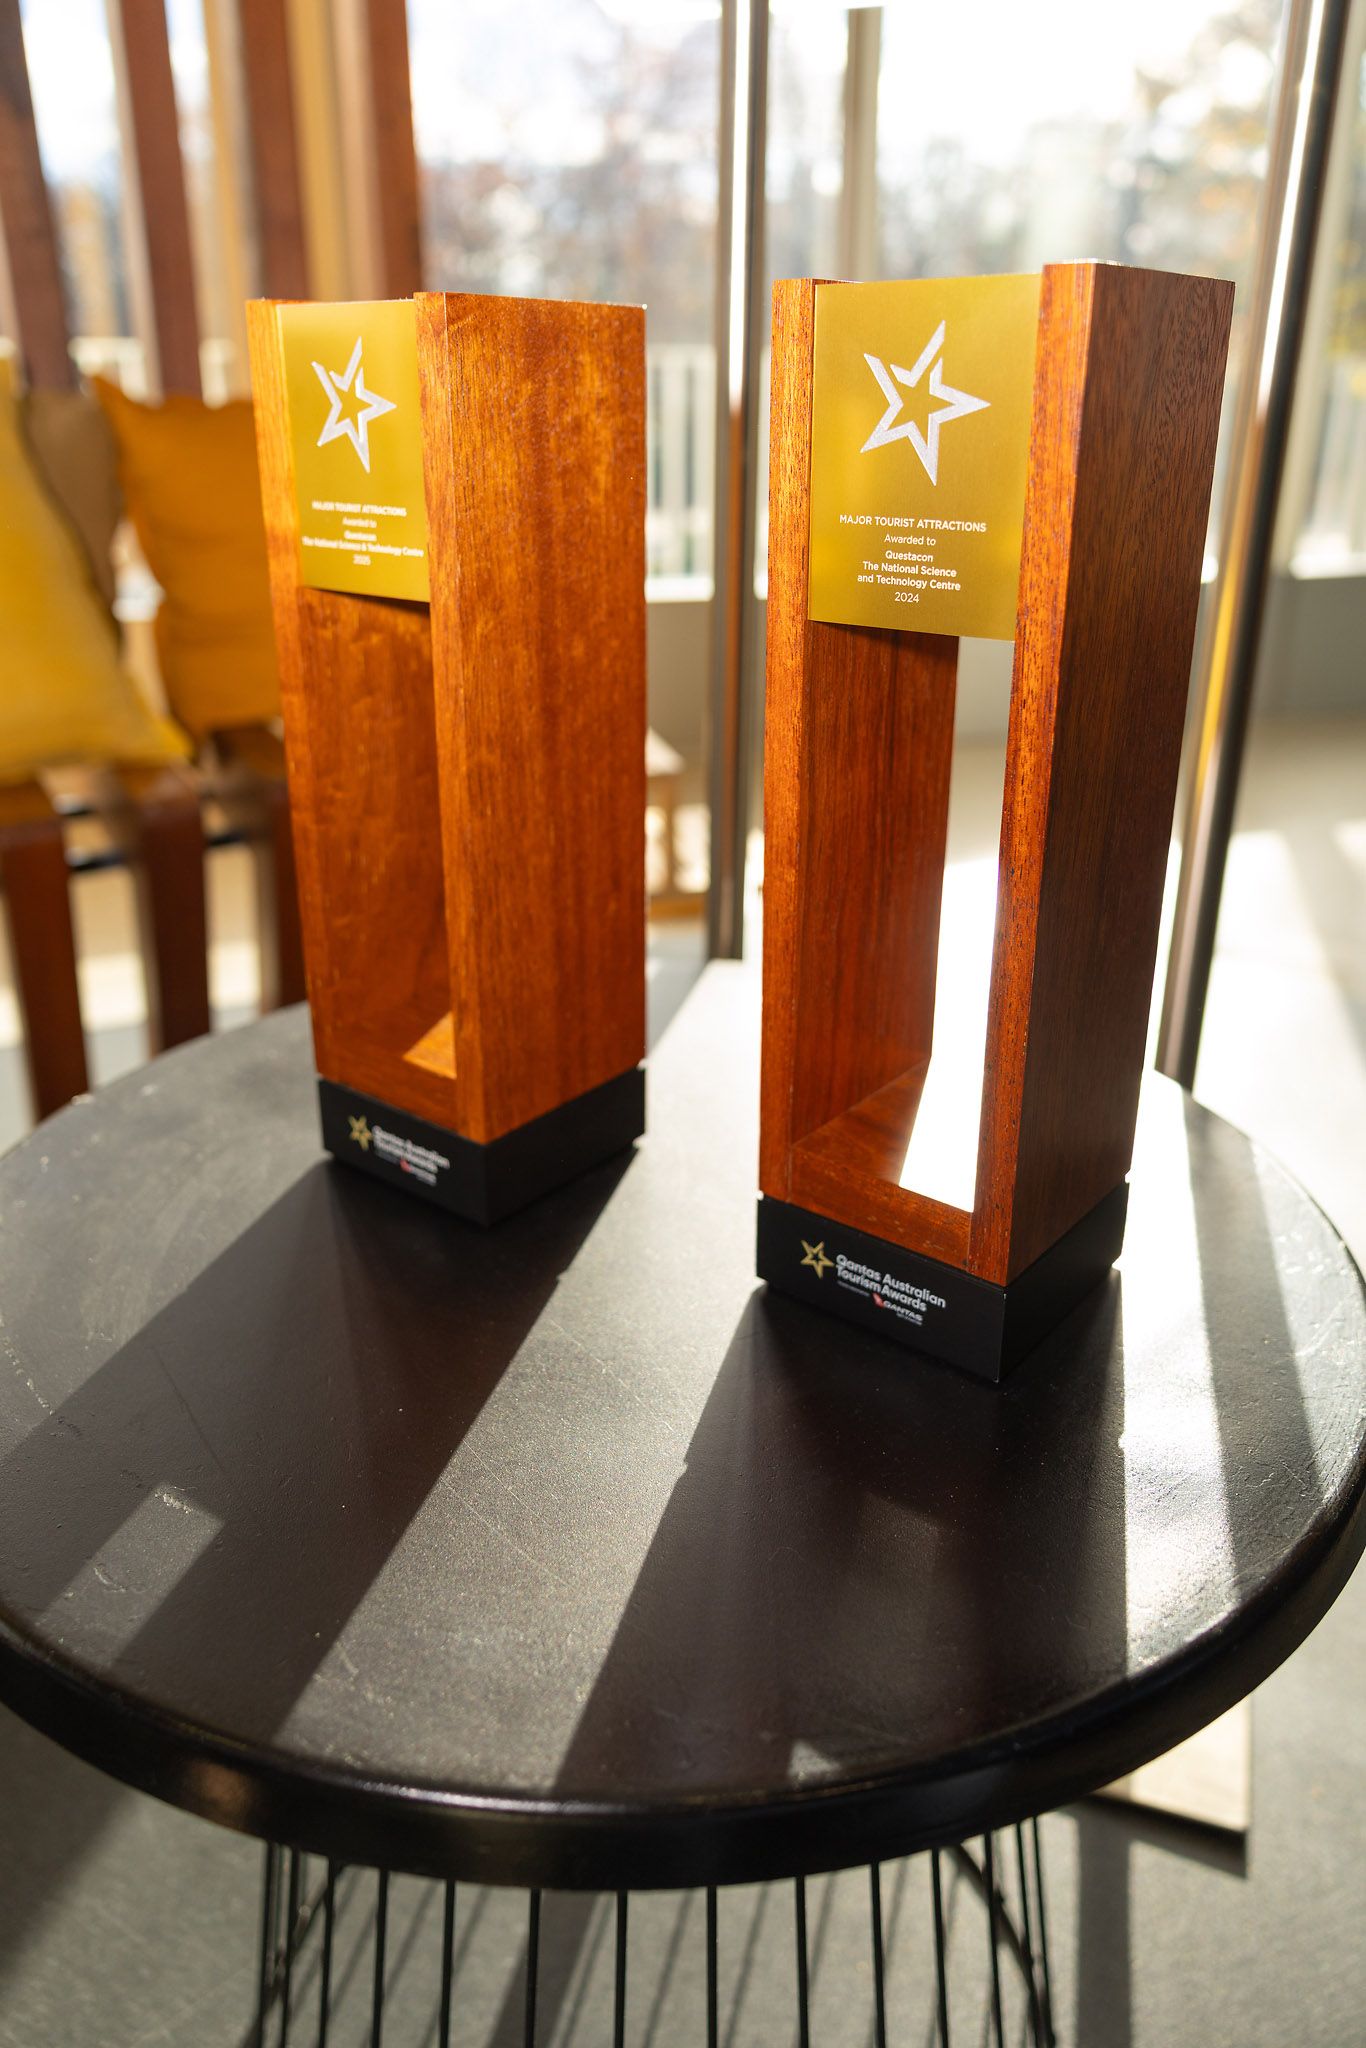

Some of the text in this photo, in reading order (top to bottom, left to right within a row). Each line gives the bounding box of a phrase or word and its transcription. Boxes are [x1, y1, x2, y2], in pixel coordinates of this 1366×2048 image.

[839, 514, 987, 532] MAJOR TOURIST ATTRACTIONS
[884, 533, 936, 546] Awarded to
[885, 550, 934, 562] Questacon
[862, 560, 957, 578] The National Science
[857, 573, 961, 591] and Technology Centre
[894, 591, 920, 604] 2024
[836, 1254, 882, 1281] Qantas
[882, 1273, 946, 1308] Australian
[836, 1263, 882, 1293] Tourism
[881, 1284, 927, 1312] Awards
[883, 1300, 923, 1321] QANTAS
